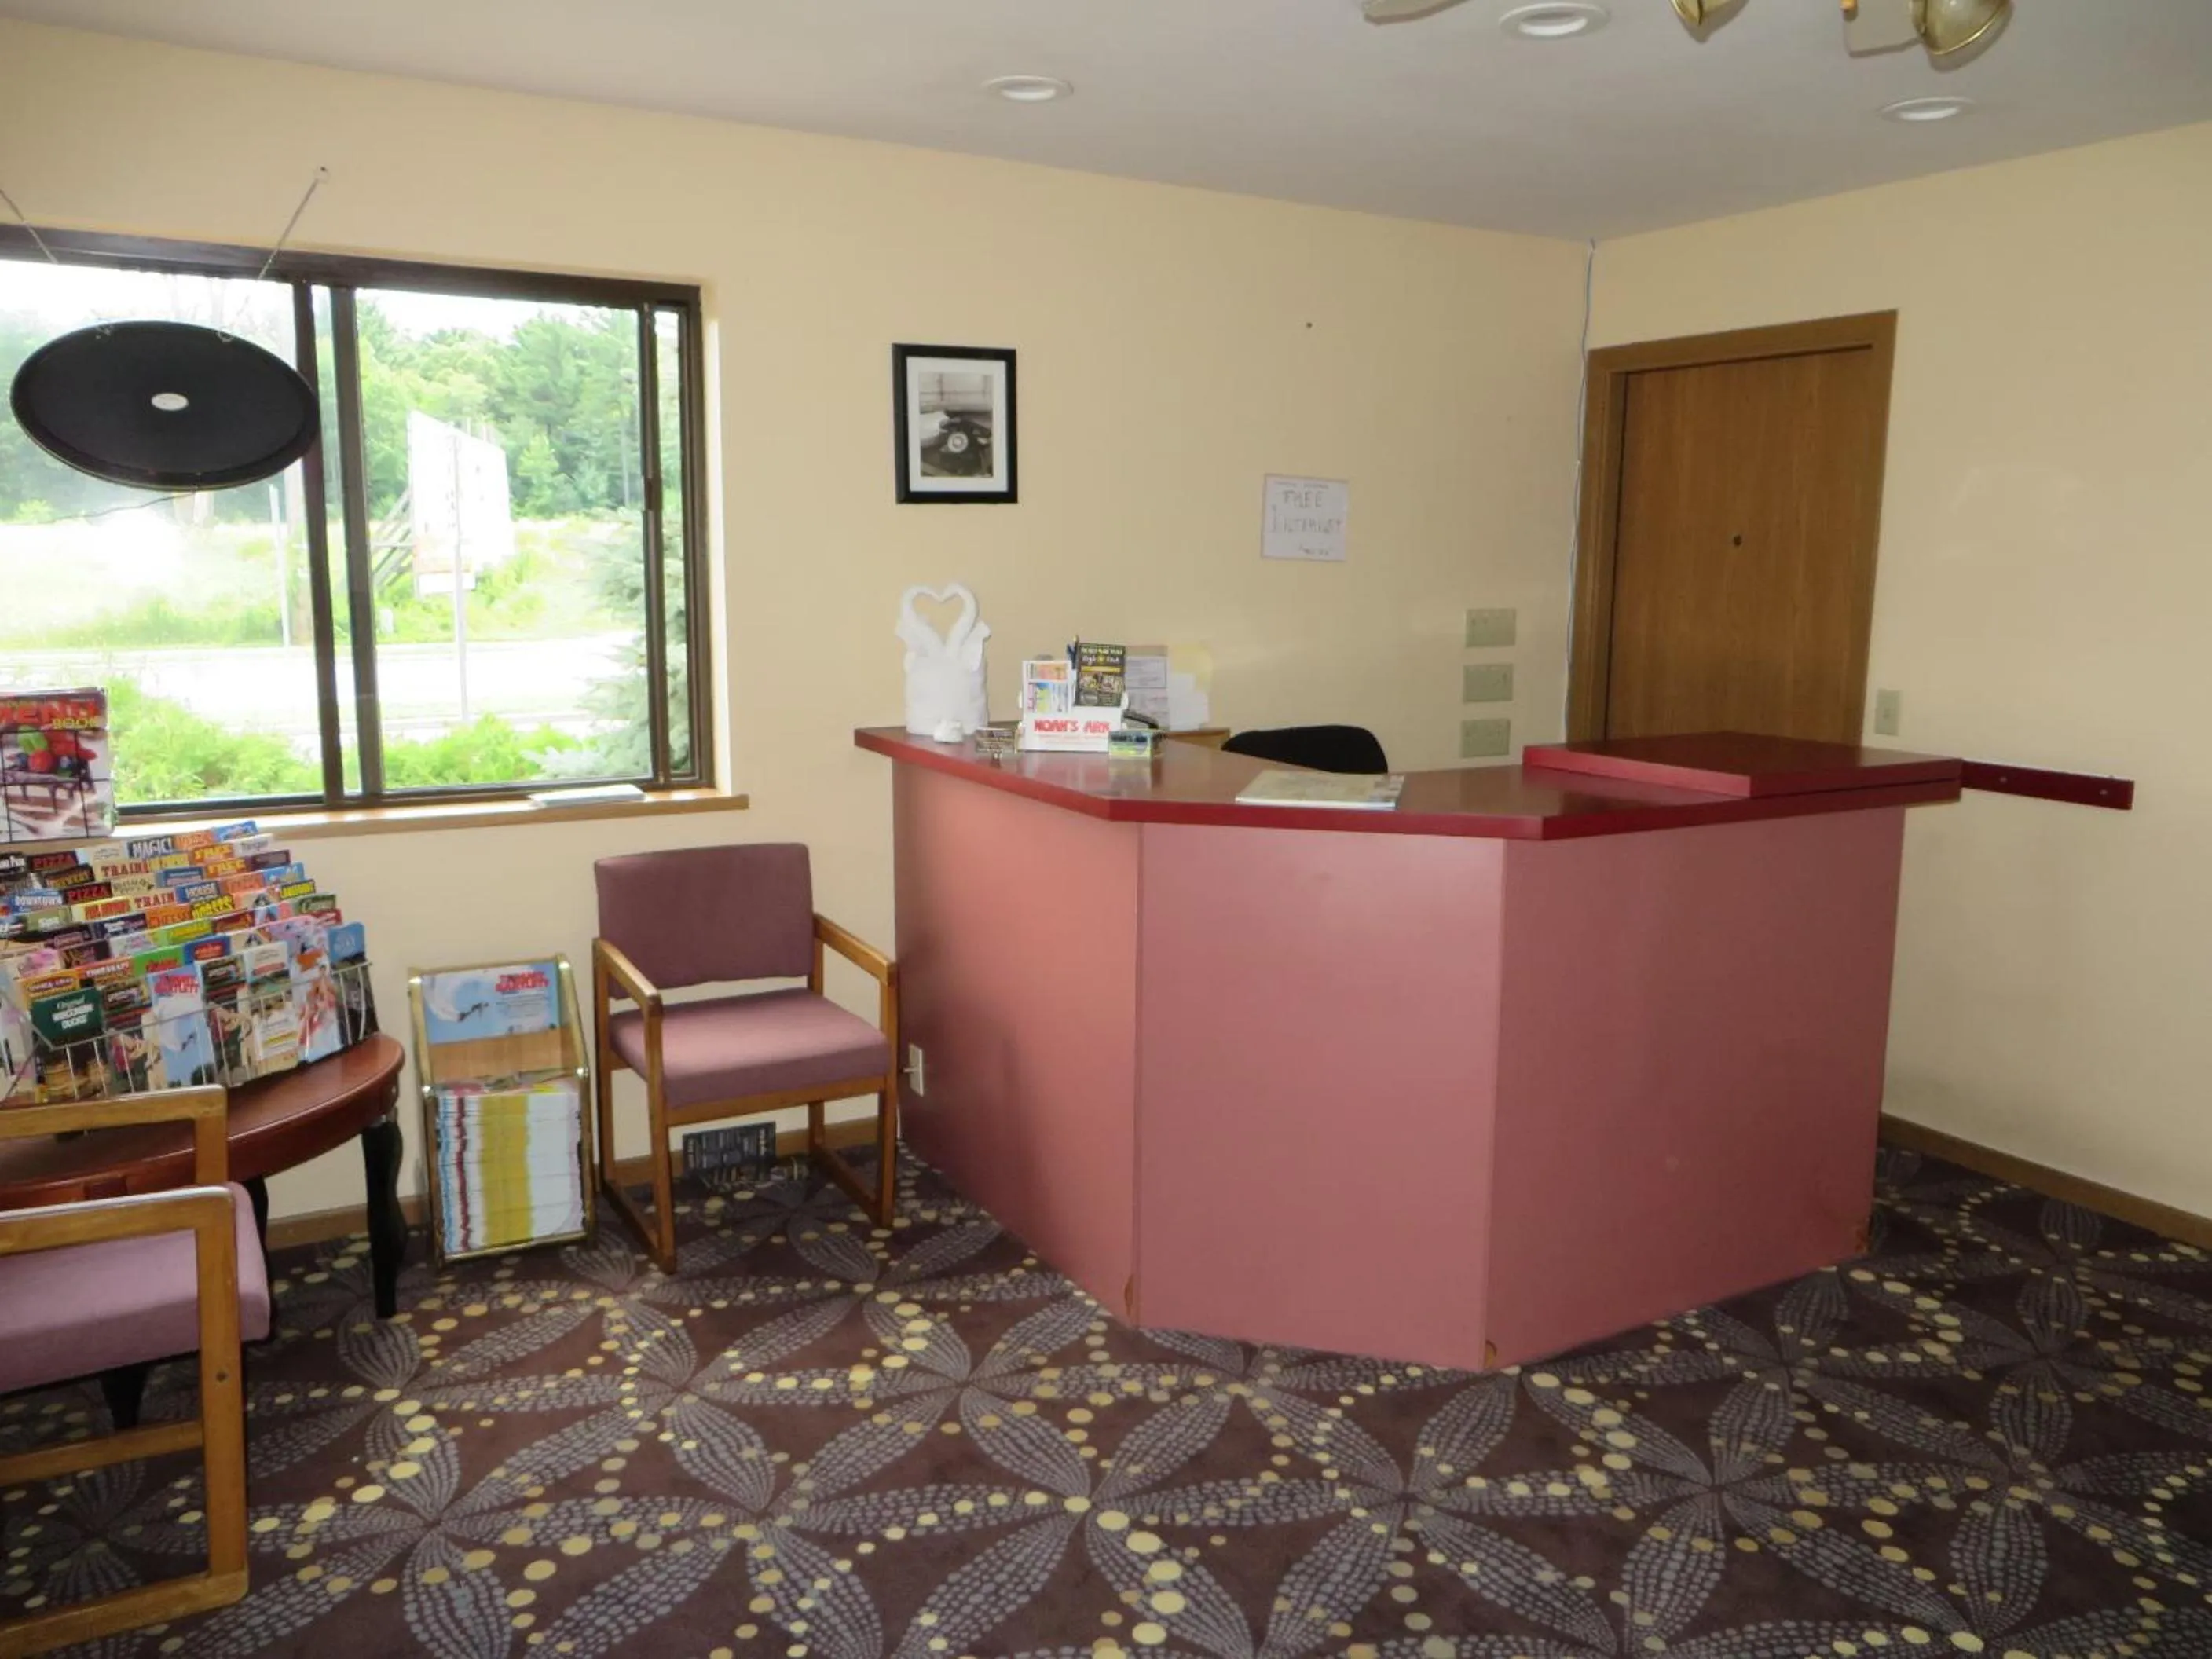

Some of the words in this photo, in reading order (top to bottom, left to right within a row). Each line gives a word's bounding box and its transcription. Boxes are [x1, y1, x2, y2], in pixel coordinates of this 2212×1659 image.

[1034, 719, 1079, 732] NOAH'S
[1084, 720, 1111, 734] ARK
[68, 884, 107, 903] PIZZA
[134, 892, 174, 908] TRAIN
